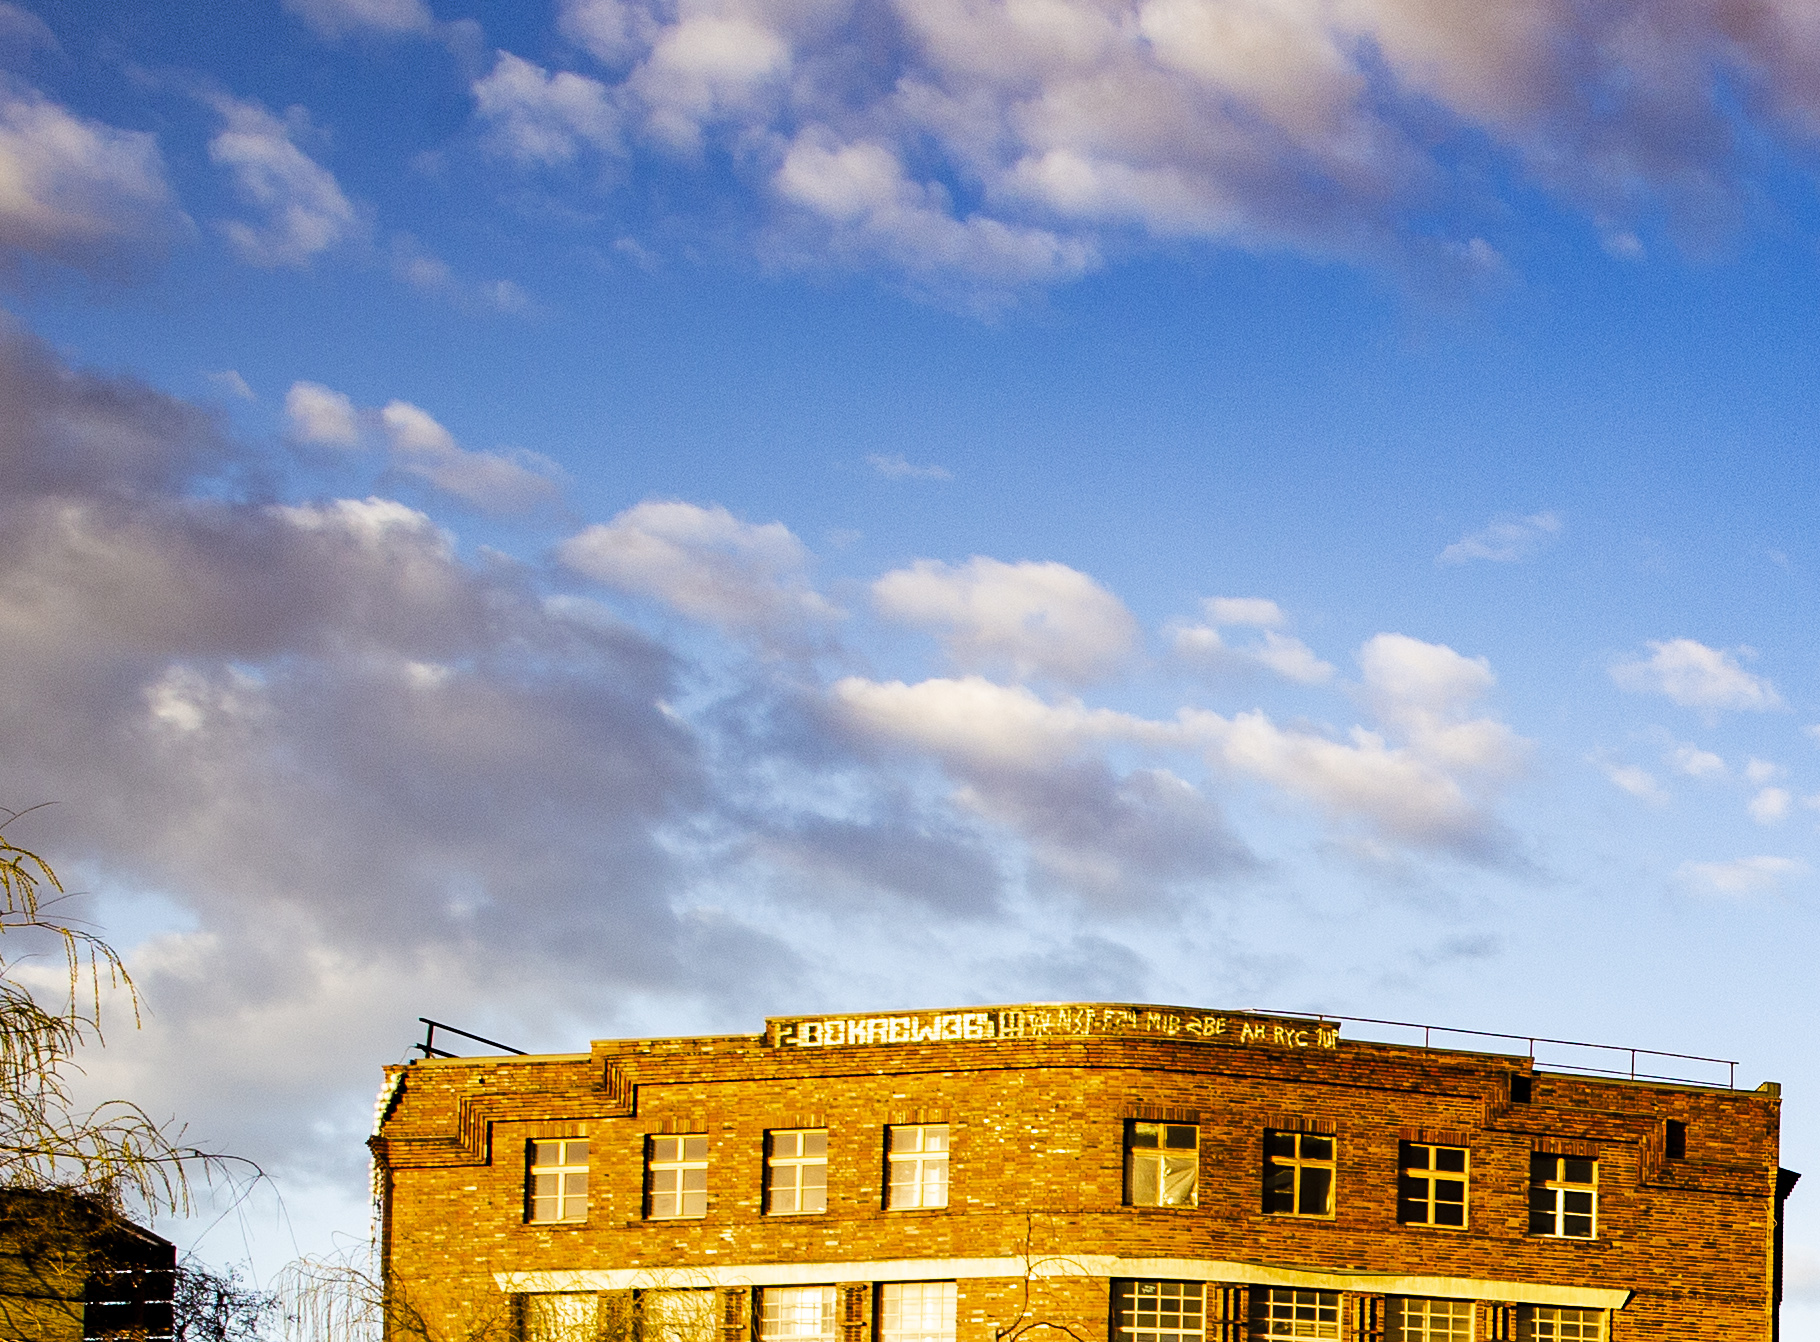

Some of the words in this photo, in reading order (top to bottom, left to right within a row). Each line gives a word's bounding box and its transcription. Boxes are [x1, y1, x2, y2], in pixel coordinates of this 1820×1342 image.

[1240, 1021, 1266, 1044] AH
[1274, 1026, 1309, 1049] RYC
[1315, 1027, 1341, 1050] 1UP
